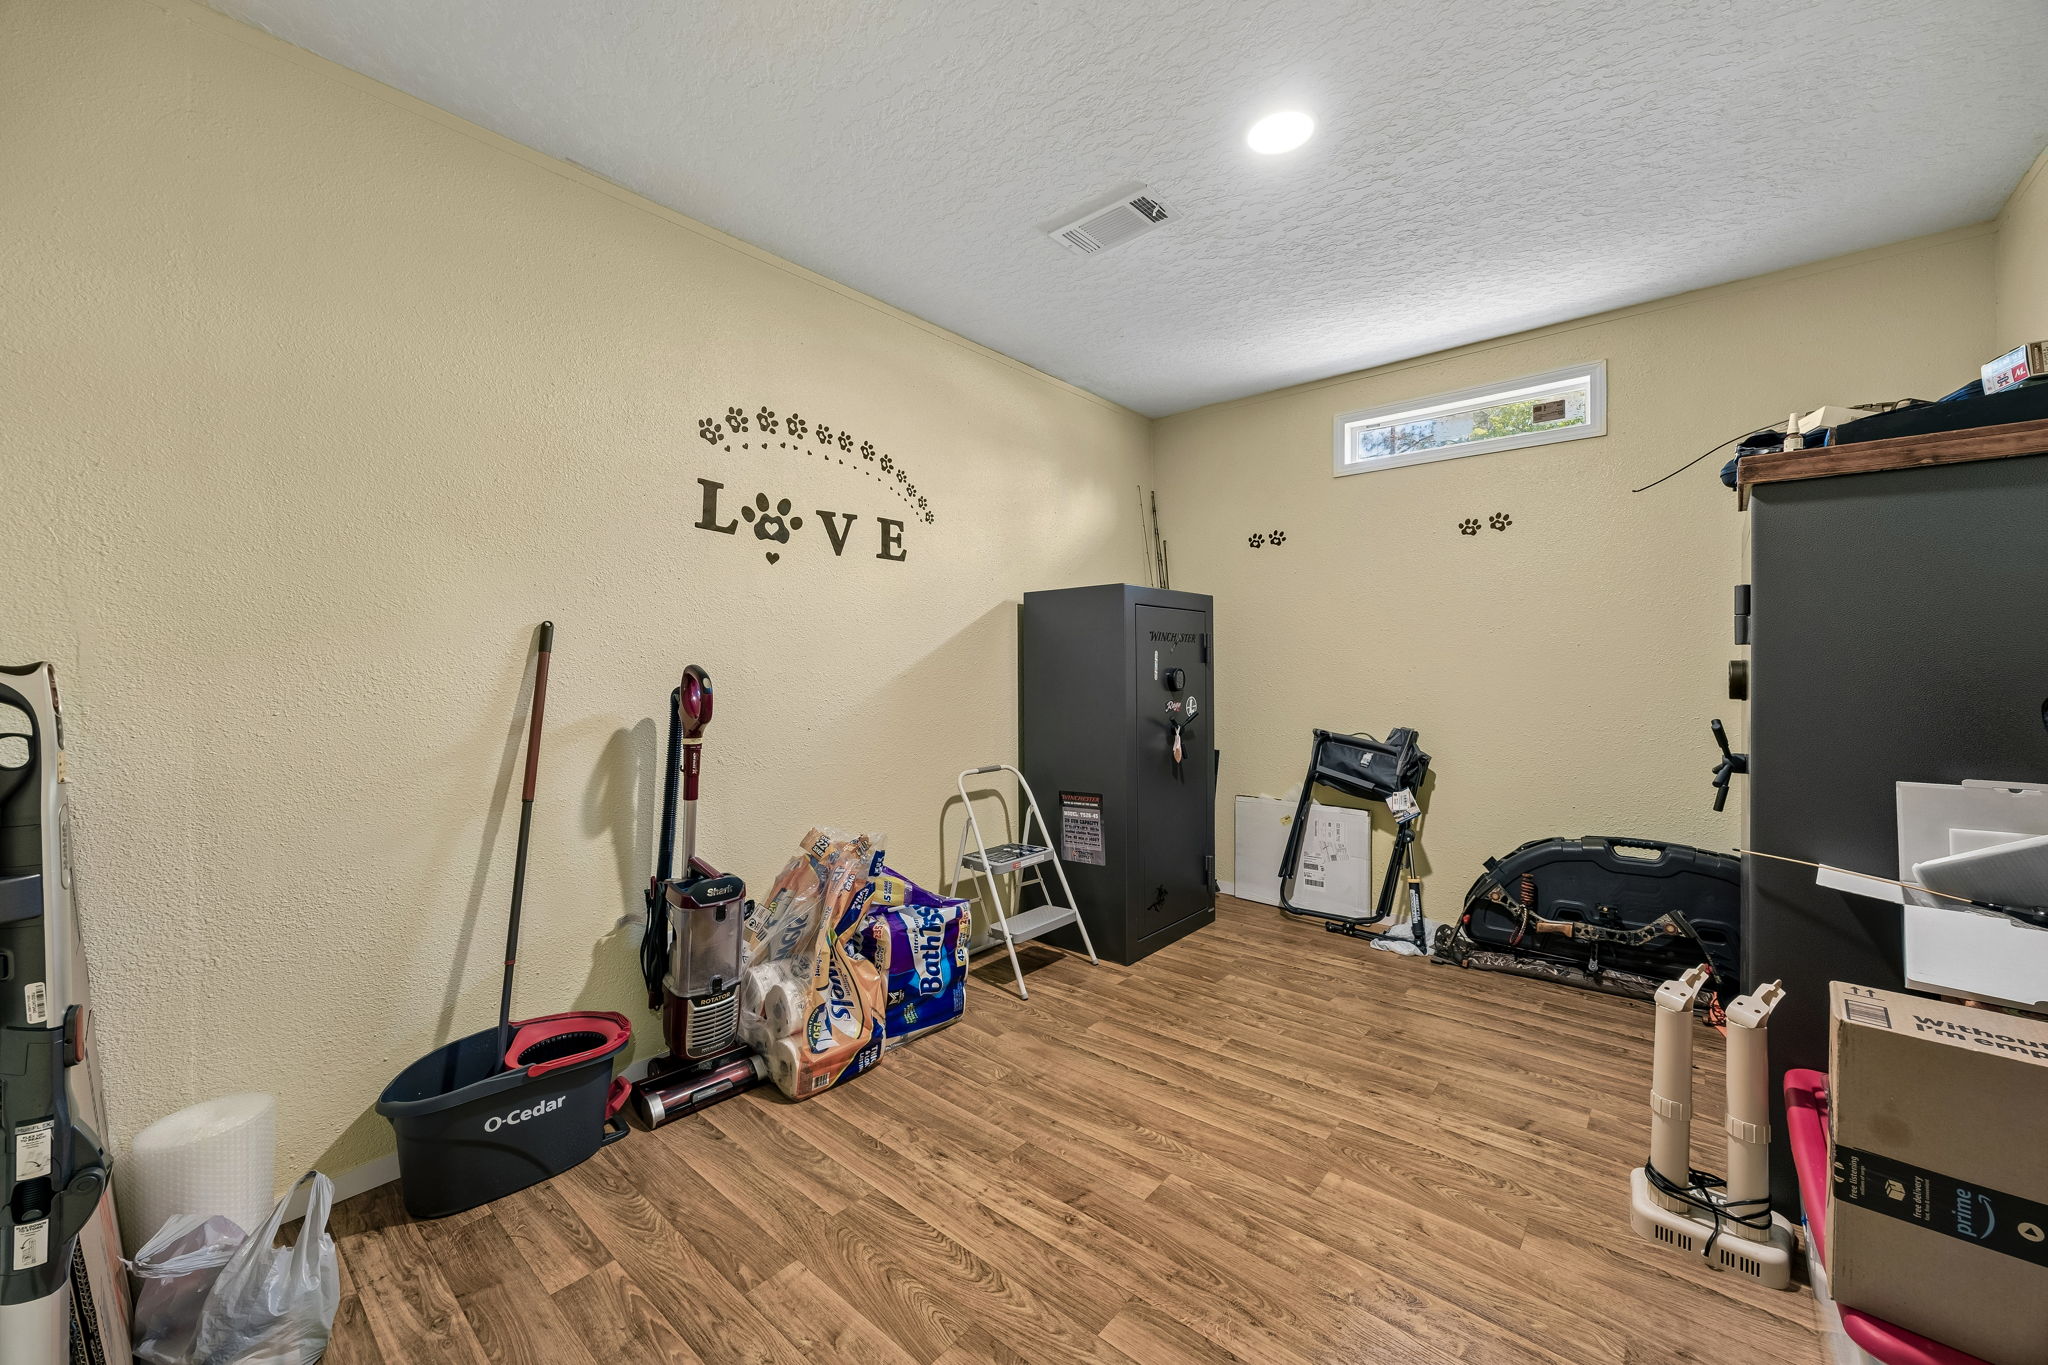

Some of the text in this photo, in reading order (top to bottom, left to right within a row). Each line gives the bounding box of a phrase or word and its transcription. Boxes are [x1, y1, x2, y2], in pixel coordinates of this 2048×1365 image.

[706, 884, 734, 897] Shark
[919, 936, 943, 994] Bath
[700, 992, 731, 1005] ROTATOR
[813, 1021, 821, 1038] 150
[1916, 1023, 1966, 1040] I'm
[484, 1096, 566, 1132] O-Cedar
[1849, 1156, 1859, 1199] free listening
[1913, 1176, 1923, 1218] free delivery
[1952, 1188, 1977, 1238] prime
